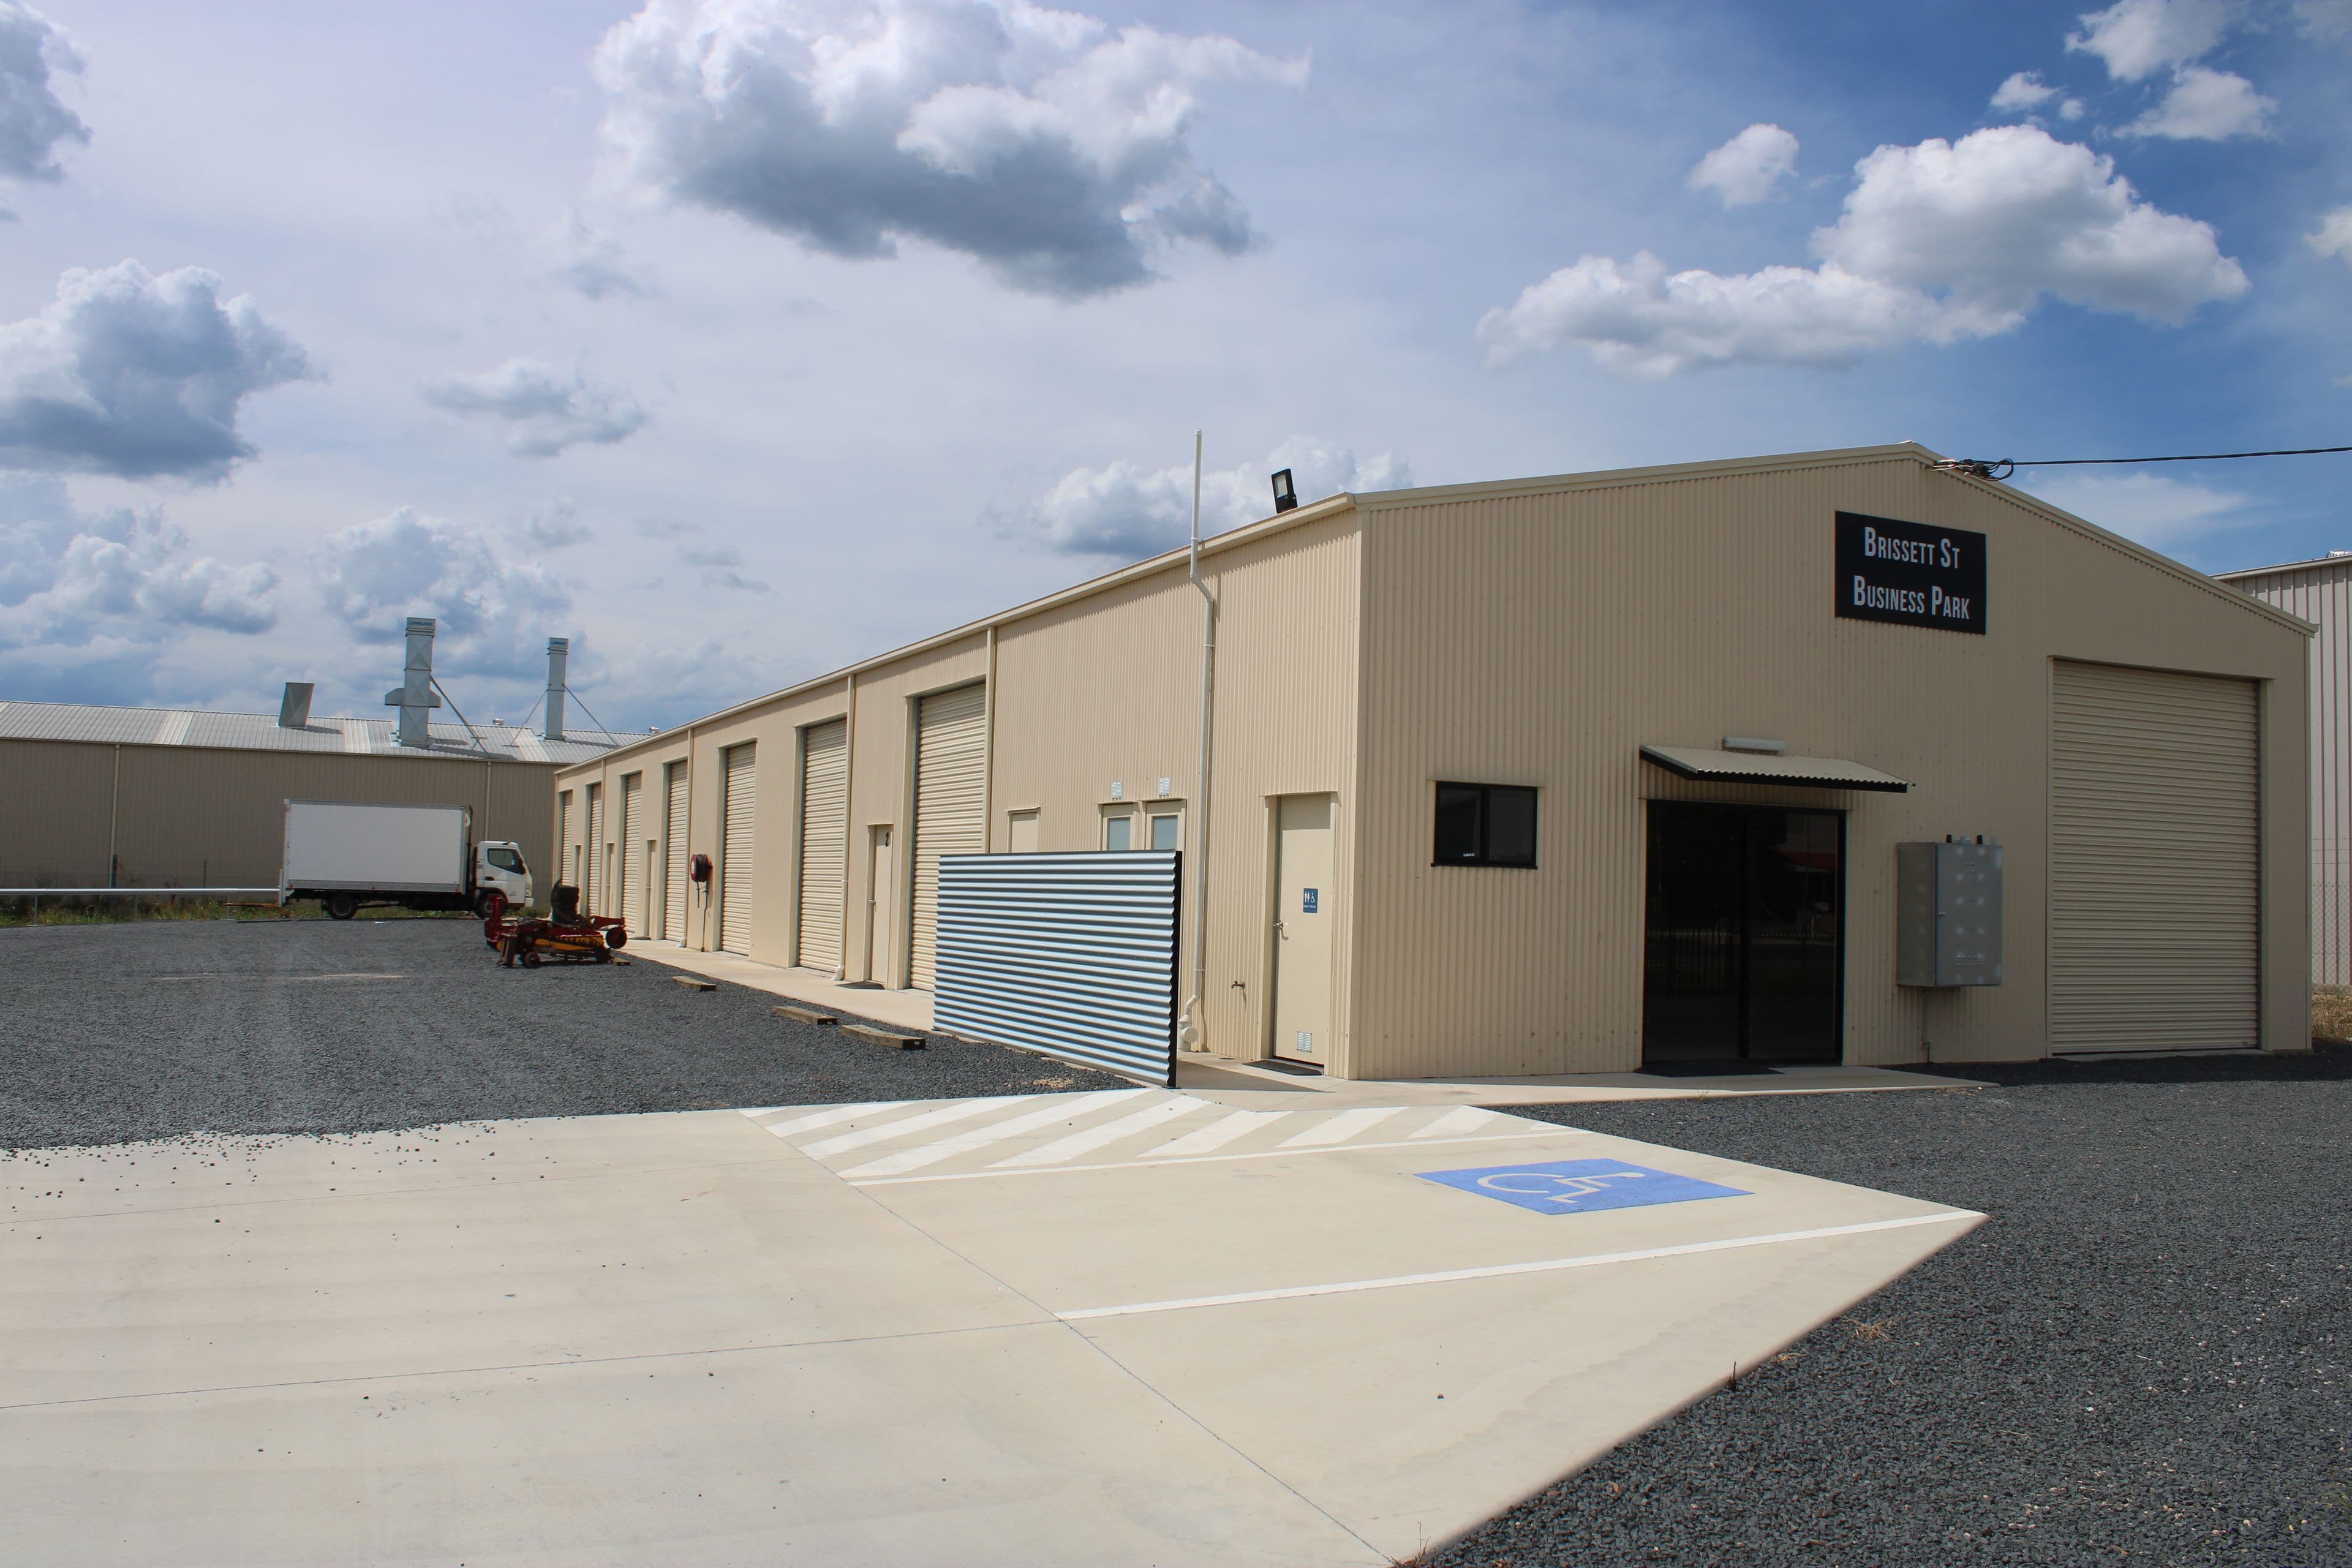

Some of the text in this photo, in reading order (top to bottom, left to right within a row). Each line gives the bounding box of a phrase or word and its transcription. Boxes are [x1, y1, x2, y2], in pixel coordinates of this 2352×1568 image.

[1864, 526, 1960, 569] BRISSETT ST
[1853, 575, 1970, 620] BUSINESS PARK
